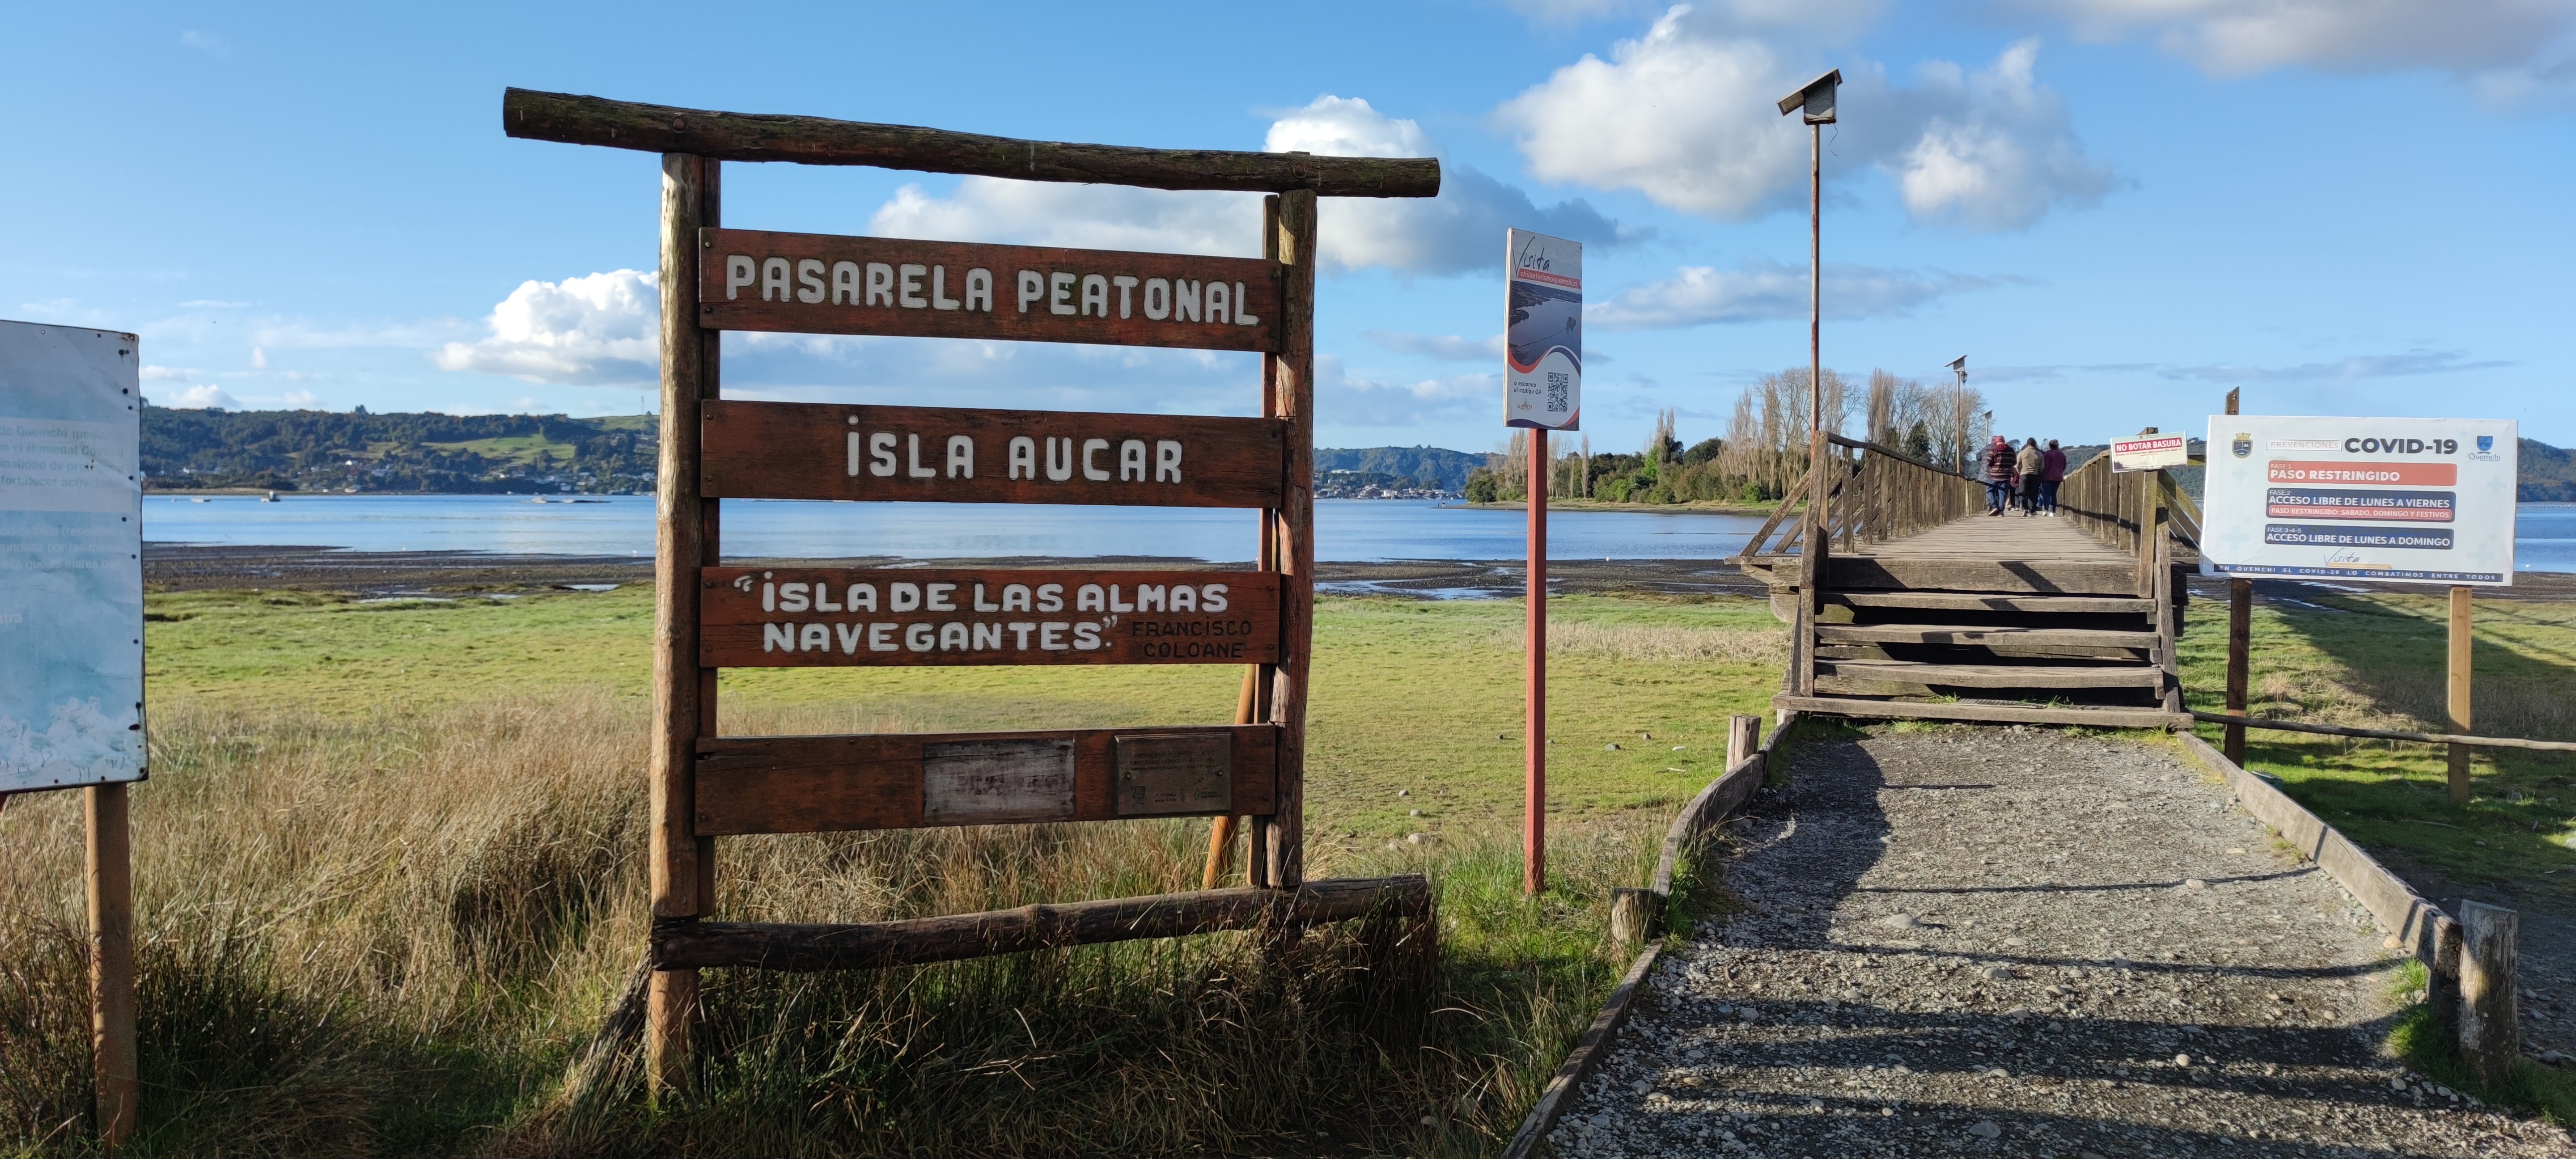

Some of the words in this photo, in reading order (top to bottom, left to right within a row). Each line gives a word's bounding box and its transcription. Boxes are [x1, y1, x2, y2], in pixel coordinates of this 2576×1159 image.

[1512, 236, 1550, 278] Visita
[1520, 270, 1578, 287] chiloeturismoquemchi.cl
[726, 254, 992, 313] PASARELA
[1017, 269, 1259, 326] PEATONAL
[2128, 442, 2152, 451] BOTAR
[2153, 439, 2182, 448] BASURA
[2345, 437, 2458, 454] COVID-19
[1008, 436, 1182, 484] AUCAR
[2270, 470, 2306, 480] PASO
[2309, 470, 2400, 482] RESTRINGIDO
[2268, 496, 2311, 504] ACCESO
[2313, 497, 2342, 505] LIBRE
[2344, 497, 2359, 506] DE
[2360, 498, 2394, 506] LUNES
[2396, 499, 2404, 507] A
[2406, 499, 2450, 508] VIERNES
[2267, 533, 2307, 541] ACCESO
[2309, 534, 2337, 542] LIBRE
[2339, 535, 2352, 543] DE
[2355, 536, 2387, 544] LUNES
[2389, 537, 2396, 545] A
[2398, 537, 2450, 546] DOMINGO
[2323, 547, 2360, 567] Visita
[890, 582, 958, 612] DE
[974, 583, 1065, 612] LAS
[1076, 583, 1229, 613] ALMAS
[1143, 642, 1245, 659] COLOANE
